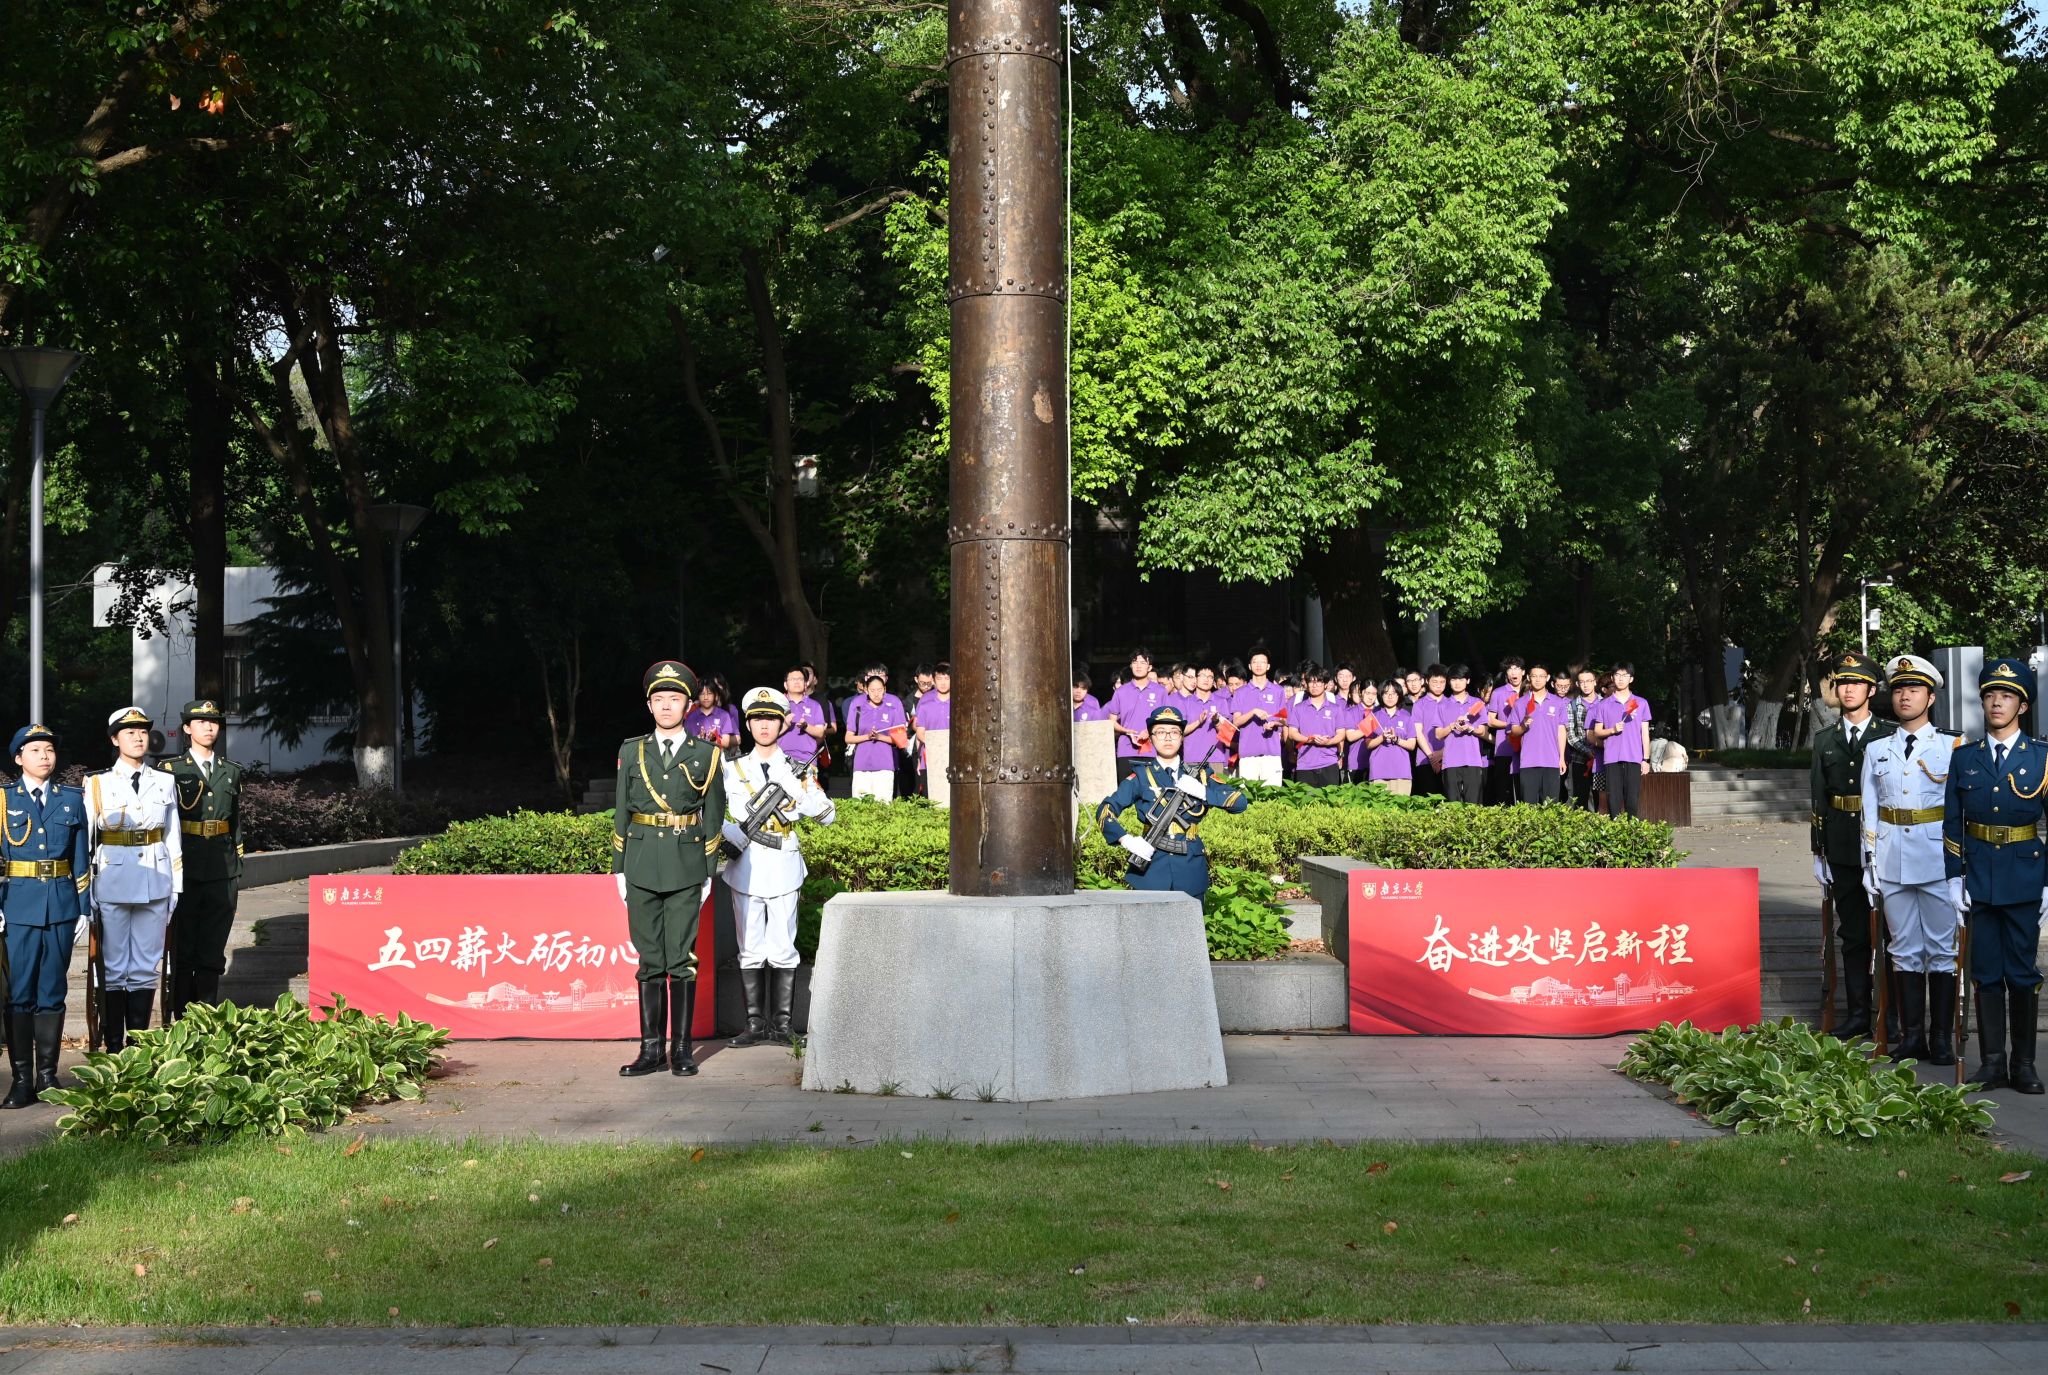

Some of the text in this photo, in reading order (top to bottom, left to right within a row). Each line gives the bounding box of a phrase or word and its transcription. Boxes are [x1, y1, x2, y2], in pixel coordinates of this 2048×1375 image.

[1416, 914, 1694, 973] 奋进攻坚启新程
